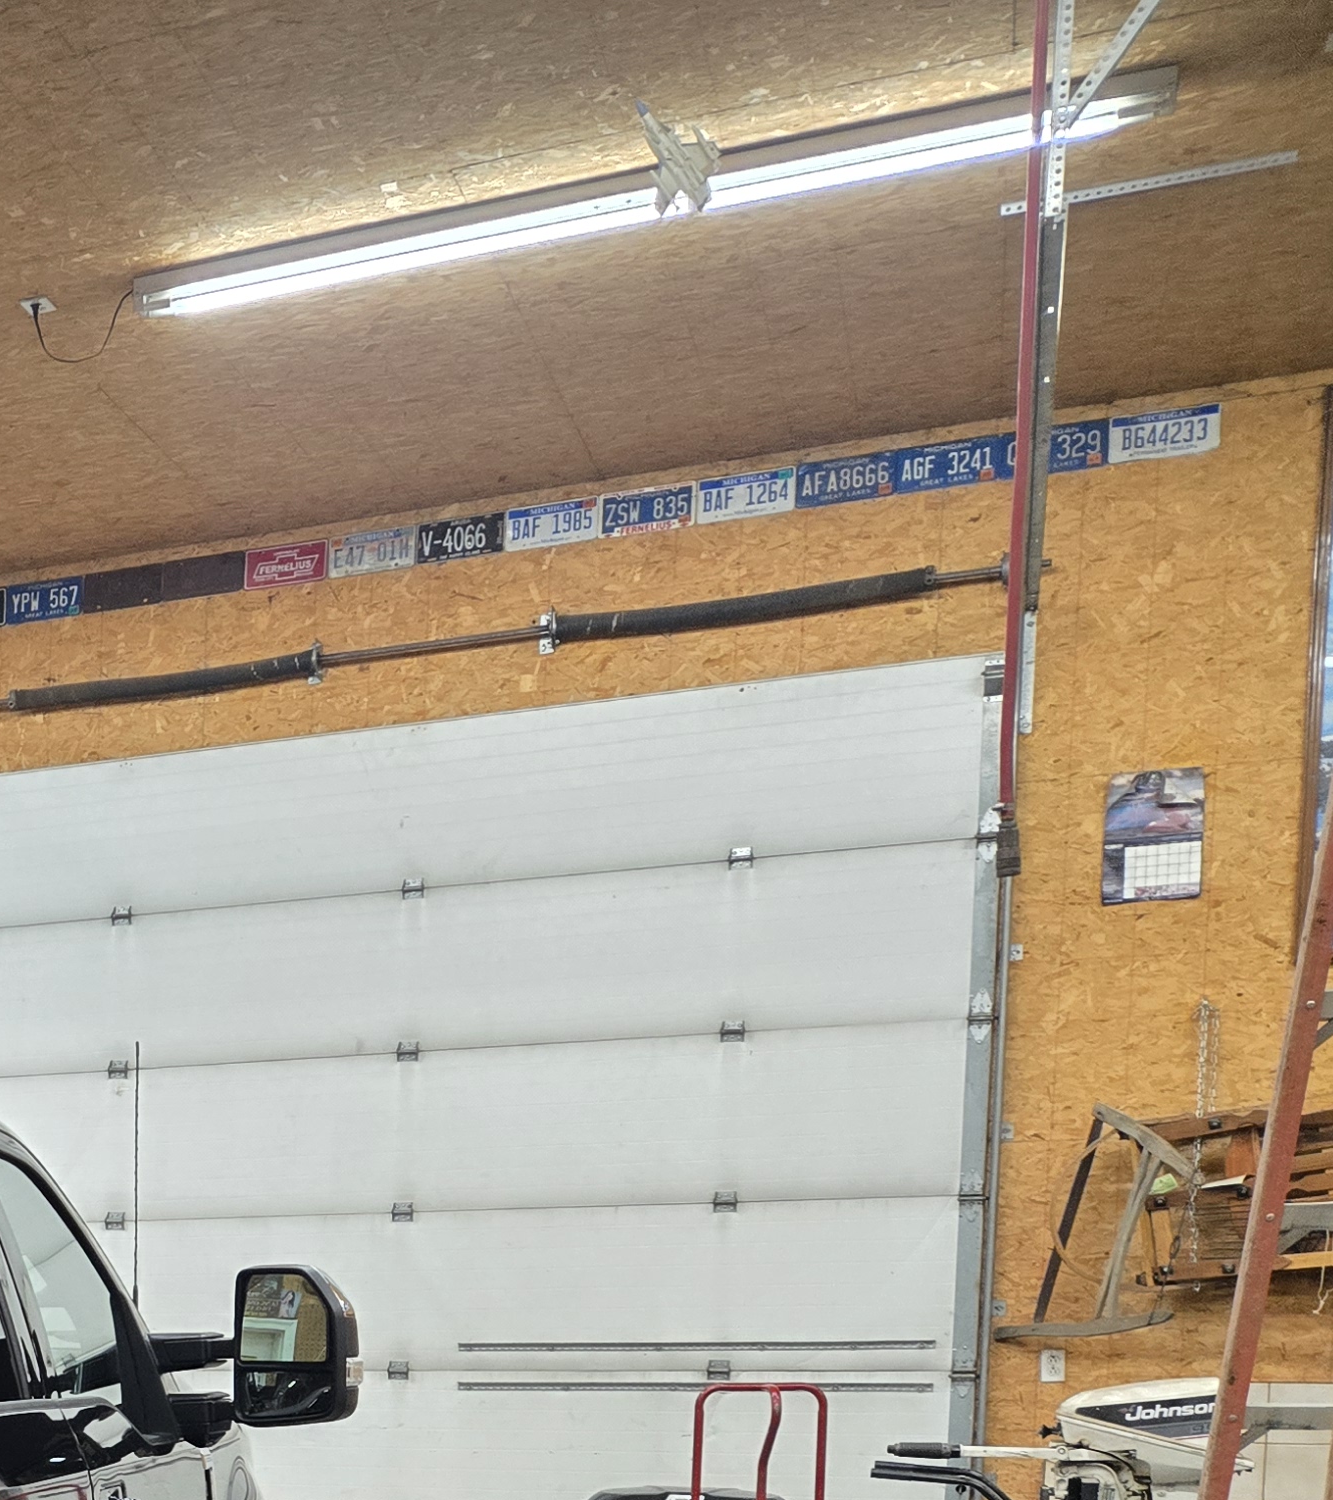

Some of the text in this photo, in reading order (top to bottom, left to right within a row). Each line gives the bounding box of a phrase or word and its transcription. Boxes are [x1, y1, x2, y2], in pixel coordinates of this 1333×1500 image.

[1056, 429, 1102, 460] 329
[1121, 417, 1209, 451] B644233
[721, 473, 772, 487] MICHIGAN
[801, 461, 890, 498] AFA8666
[901, 456, 936, 482] AGF
[946, 446, 994, 475] 3241
[528, 502, 577, 516] MICHIGAN
[605, 501, 641, 528] ZSW
[652, 493, 690, 520] 835
[702, 488, 735, 514] BAF
[745, 480, 789, 507] 1264
[421, 522, 487, 557] V-4066
[511, 517, 542, 541] BAF
[551, 509, 593, 536] 1985
[258, 559, 313, 575] FERNELIUS
[49, 585, 79, 609] 567
